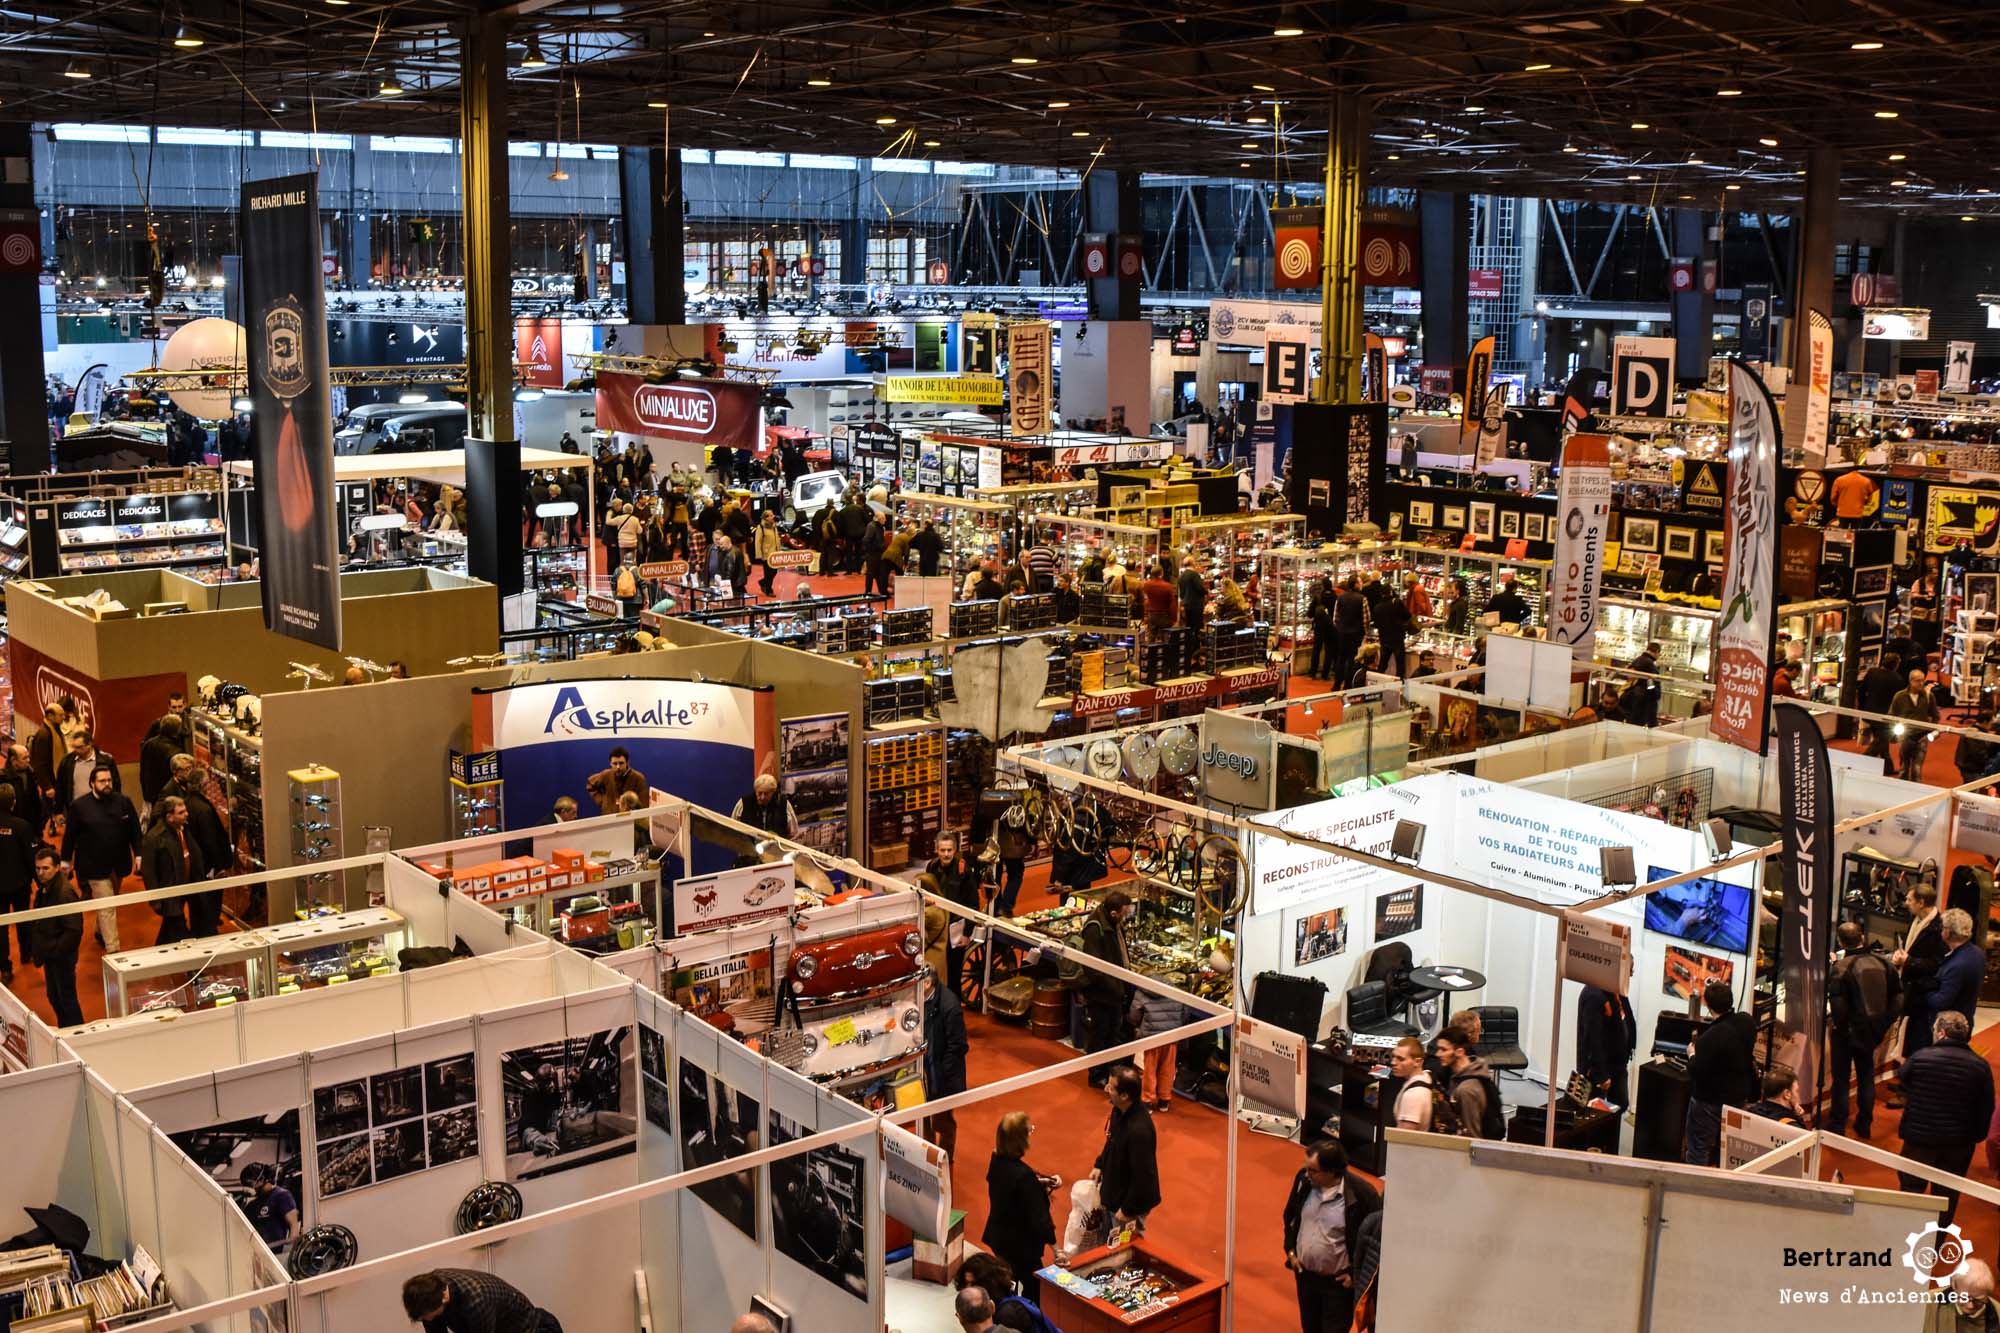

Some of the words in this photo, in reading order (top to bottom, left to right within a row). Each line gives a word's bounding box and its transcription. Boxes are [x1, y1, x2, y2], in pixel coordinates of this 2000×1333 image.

[251, 194, 282, 210] RICHARD
[283, 191, 306, 206] MILLE
[1278, 345, 1296, 388] E
[1423, 369, 1451, 378] MOTUL
[890, 379, 924, 391] MANOIR
[925, 380, 935, 392] DE
[937, 380, 1001, 394] L'AUTOMOBILE
[1626, 361, 1659, 408] D
[639, 394, 709, 423] MINIALUXE
[63, 509, 107, 520] DEDICACES
[119, 506, 161, 516] DEDICACES
[770, 553, 812, 564] MINIALUXE
[641, 563, 686, 575] MINIALUXE
[1230, 668, 1281, 688] DAN-TOYS
[1155, 681, 1209, 700] DAN-TOYS
[544, 686, 693, 735] Asphalte
[691, 701, 710, 716] 87
[1075, 692, 1132, 713] DAN-TOYS
[452, 761, 466, 777] REE
[471, 762, 499, 777] REE
[1201, 741, 1255, 779] Jeep
[471, 773, 499, 784] MODELES
[1326, 809, 1396, 837] SPÉCIALISTE
[1478, 807, 1551, 834] RÉNOVATION
[1559, 827, 1634, 849] RÉPARATIO
[1343, 834, 1357, 849] LA
[1528, 834, 1545, 846] DE
[1547, 839, 1578, 857] TOUS
[1478, 835, 1501, 850] VOS
[1503, 843, 1575, 871] RADIATEURS
[1490, 861, 1517, 876] Cuivre
[1523, 870, 1567, 889] Aluminium
[1568, 949, 1603, 965] CULASSES
[694, 966, 720, 981] BELLA
[721, 959, 749, 975] ITALIA.
[1241, 1061, 1258, 1072] FIAT
[1257, 1065, 1270, 1076] 500
[1241, 1068, 1271, 1086] PASSION
[889, 1170, 902, 1185] SAS
[902, 1177, 921, 1195] ZINDY
